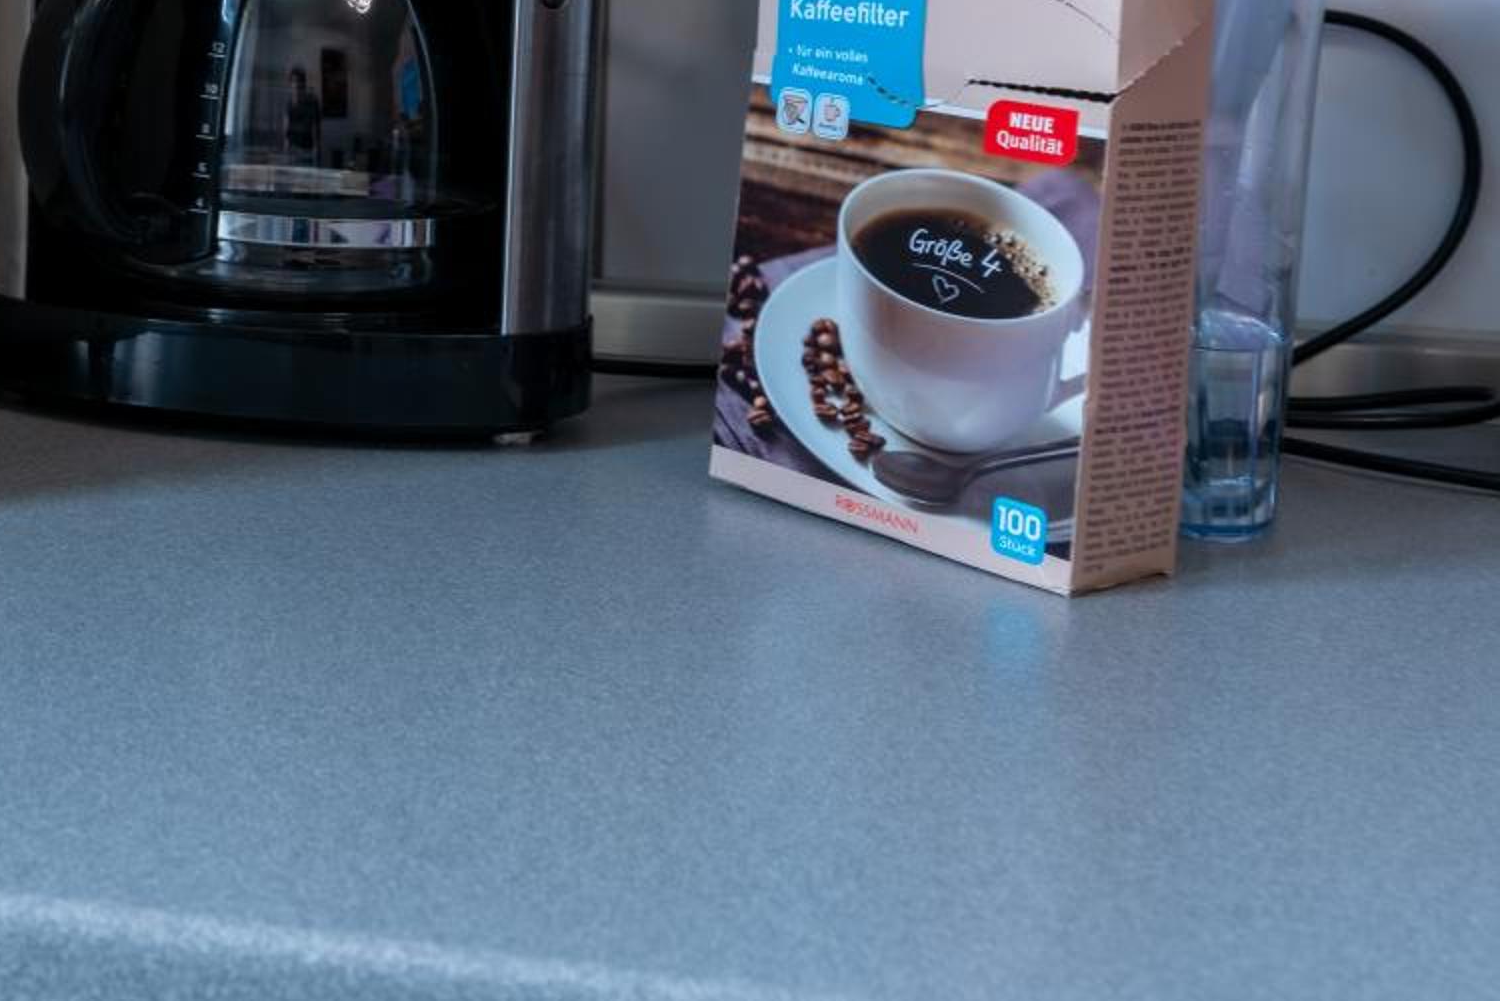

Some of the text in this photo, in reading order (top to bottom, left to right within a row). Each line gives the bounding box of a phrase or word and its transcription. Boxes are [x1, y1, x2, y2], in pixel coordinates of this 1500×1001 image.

[815, 48, 833, 60] ein
[835, 50, 869, 64] volles
[792, 63, 865, 86] Kaffeearoma
[1009, 112, 1055, 134] NEUE
[996, 130, 1064, 156] Qualität
[909, 228, 1003, 278] Größe 4
[999, 505, 1041, 542] 100
